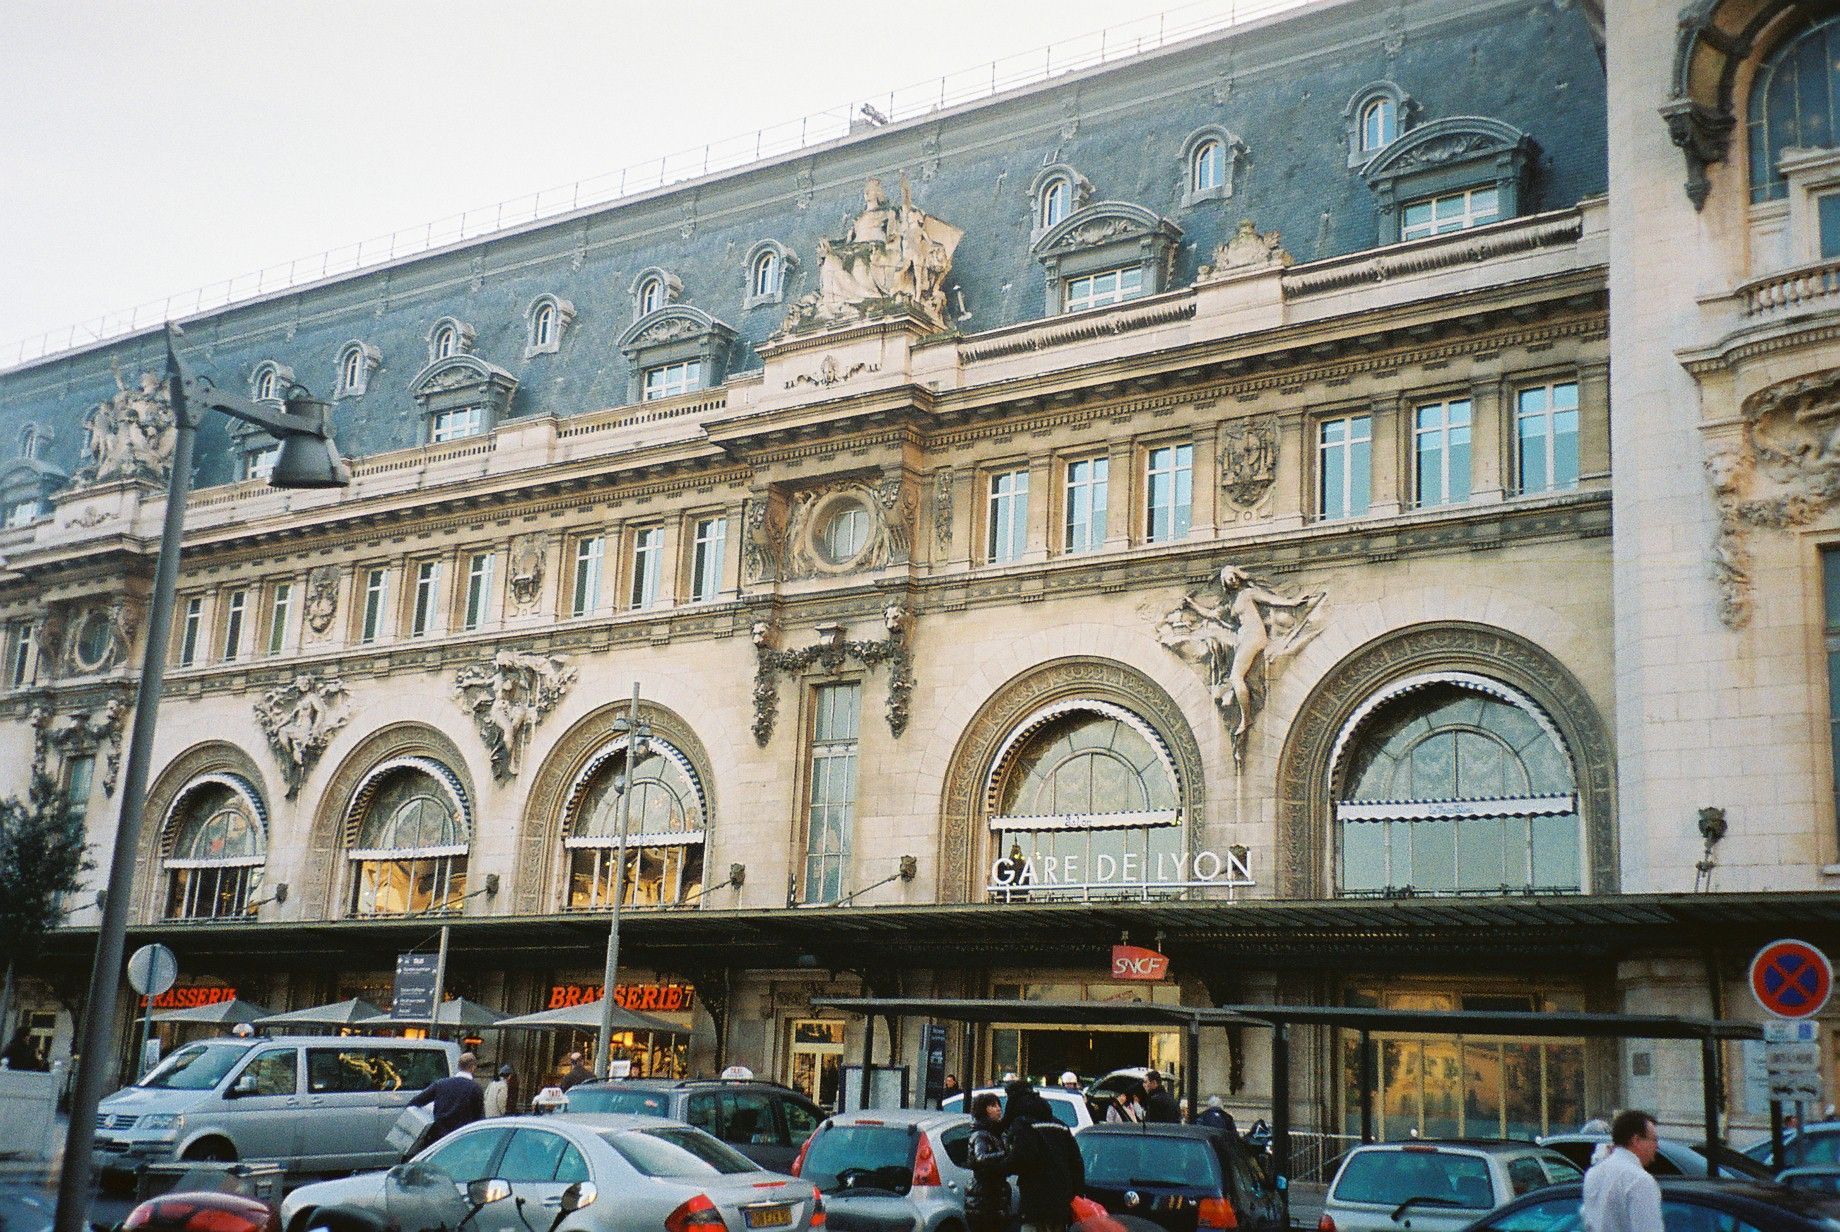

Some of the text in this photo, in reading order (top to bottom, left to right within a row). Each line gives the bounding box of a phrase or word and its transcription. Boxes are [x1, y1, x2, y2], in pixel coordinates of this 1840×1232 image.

[991, 851, 1252, 886] GARE DE LYON
[1113, 957, 1164, 975] SNCF
